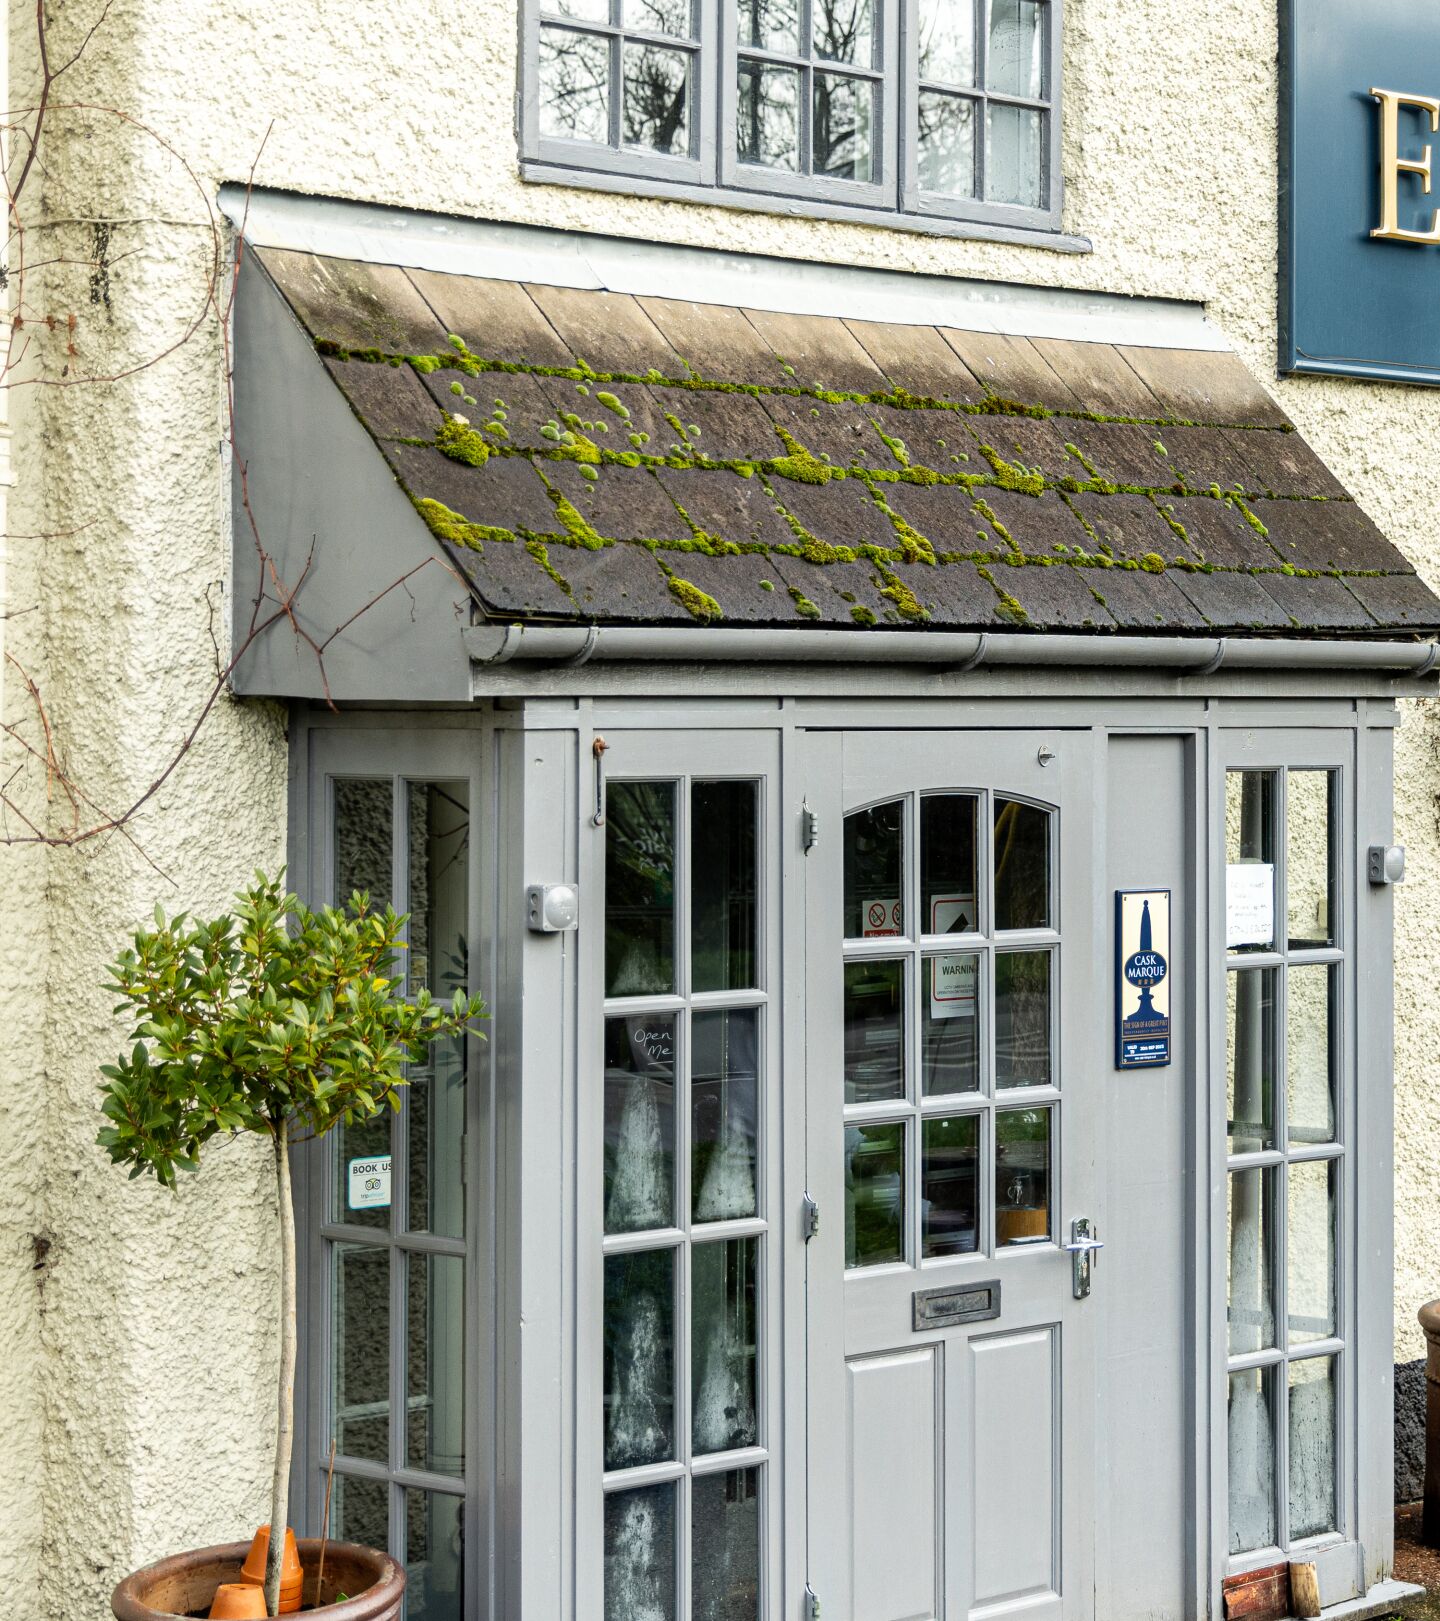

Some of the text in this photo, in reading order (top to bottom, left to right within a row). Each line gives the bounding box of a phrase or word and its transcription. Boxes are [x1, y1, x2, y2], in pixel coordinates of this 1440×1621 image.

[1134, 955, 1156, 966] CASK
[942, 965, 975, 975] WARNIN
[1128, 965, 1165, 978] MARQUE
[634, 1028, 673, 1047] Open
[647, 1044, 673, 1059] Me
[353, 1165, 377, 1174] BOOK
